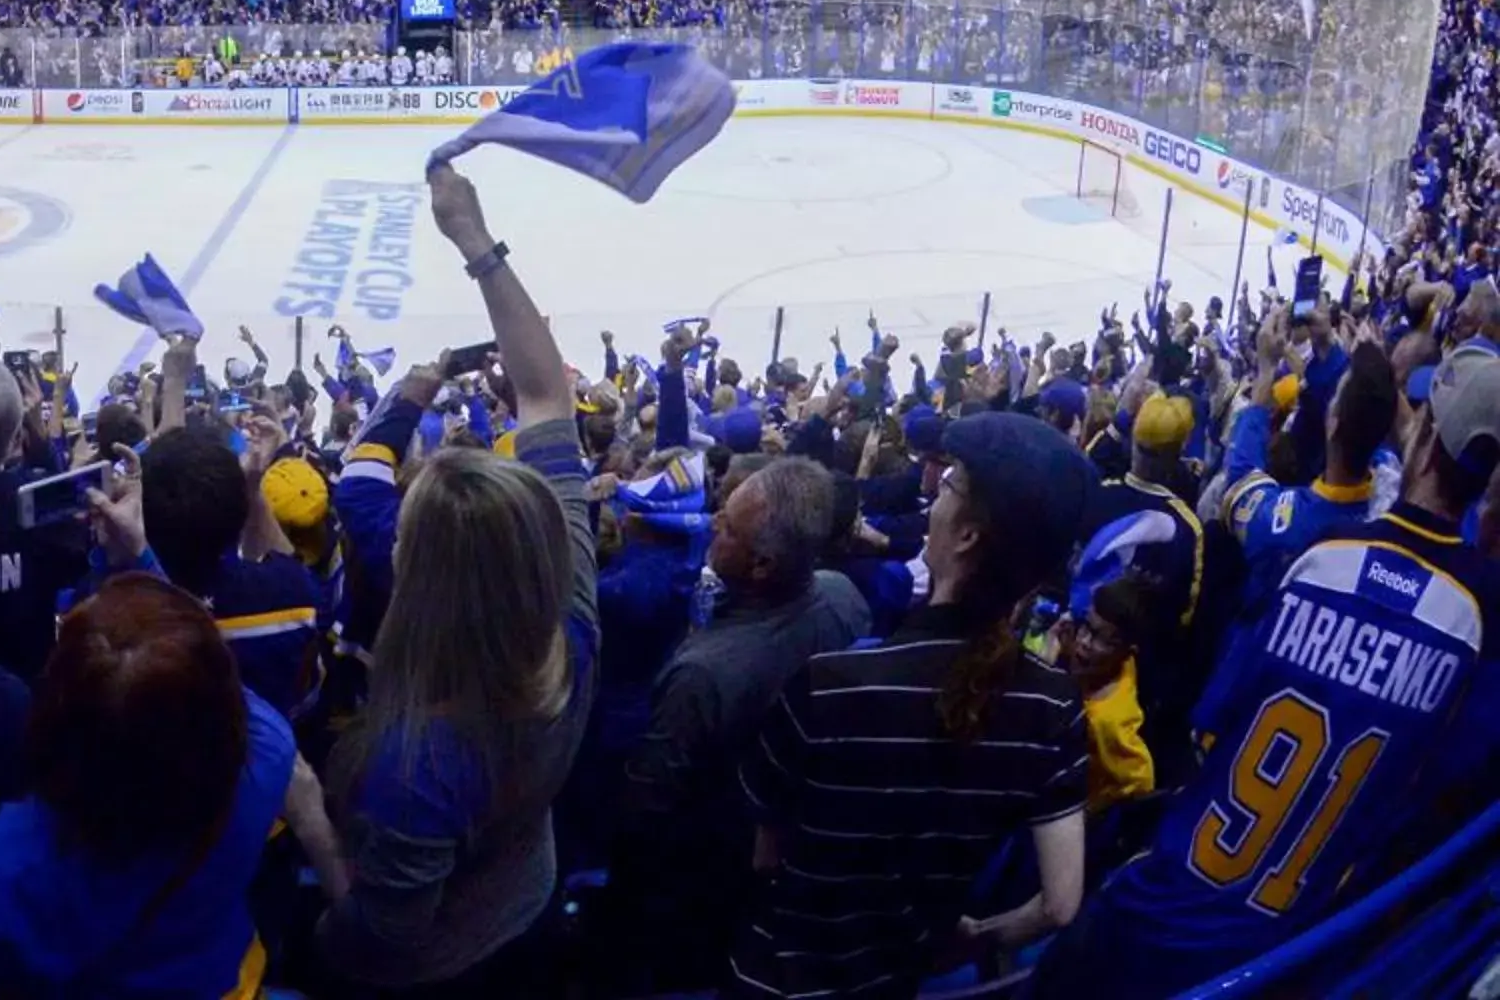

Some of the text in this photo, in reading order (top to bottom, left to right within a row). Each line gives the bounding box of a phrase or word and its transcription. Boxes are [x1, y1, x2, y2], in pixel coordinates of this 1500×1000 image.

[411, 5, 444, 17] LIGHT
[232, 98, 272, 110] LIGHT
[1080, 111, 1140, 146] HONDA
[1144, 131, 1201, 175] GEICO
[1283, 187, 1347, 239] Specrum
[274, 199, 367, 318] PLAYOFFS
[352, 269, 413, 321] CUP
[1366, 561, 1424, 599] Reebok
[1265, 592, 1461, 713] TARASENKO
[1187, 687, 1391, 917] 91
